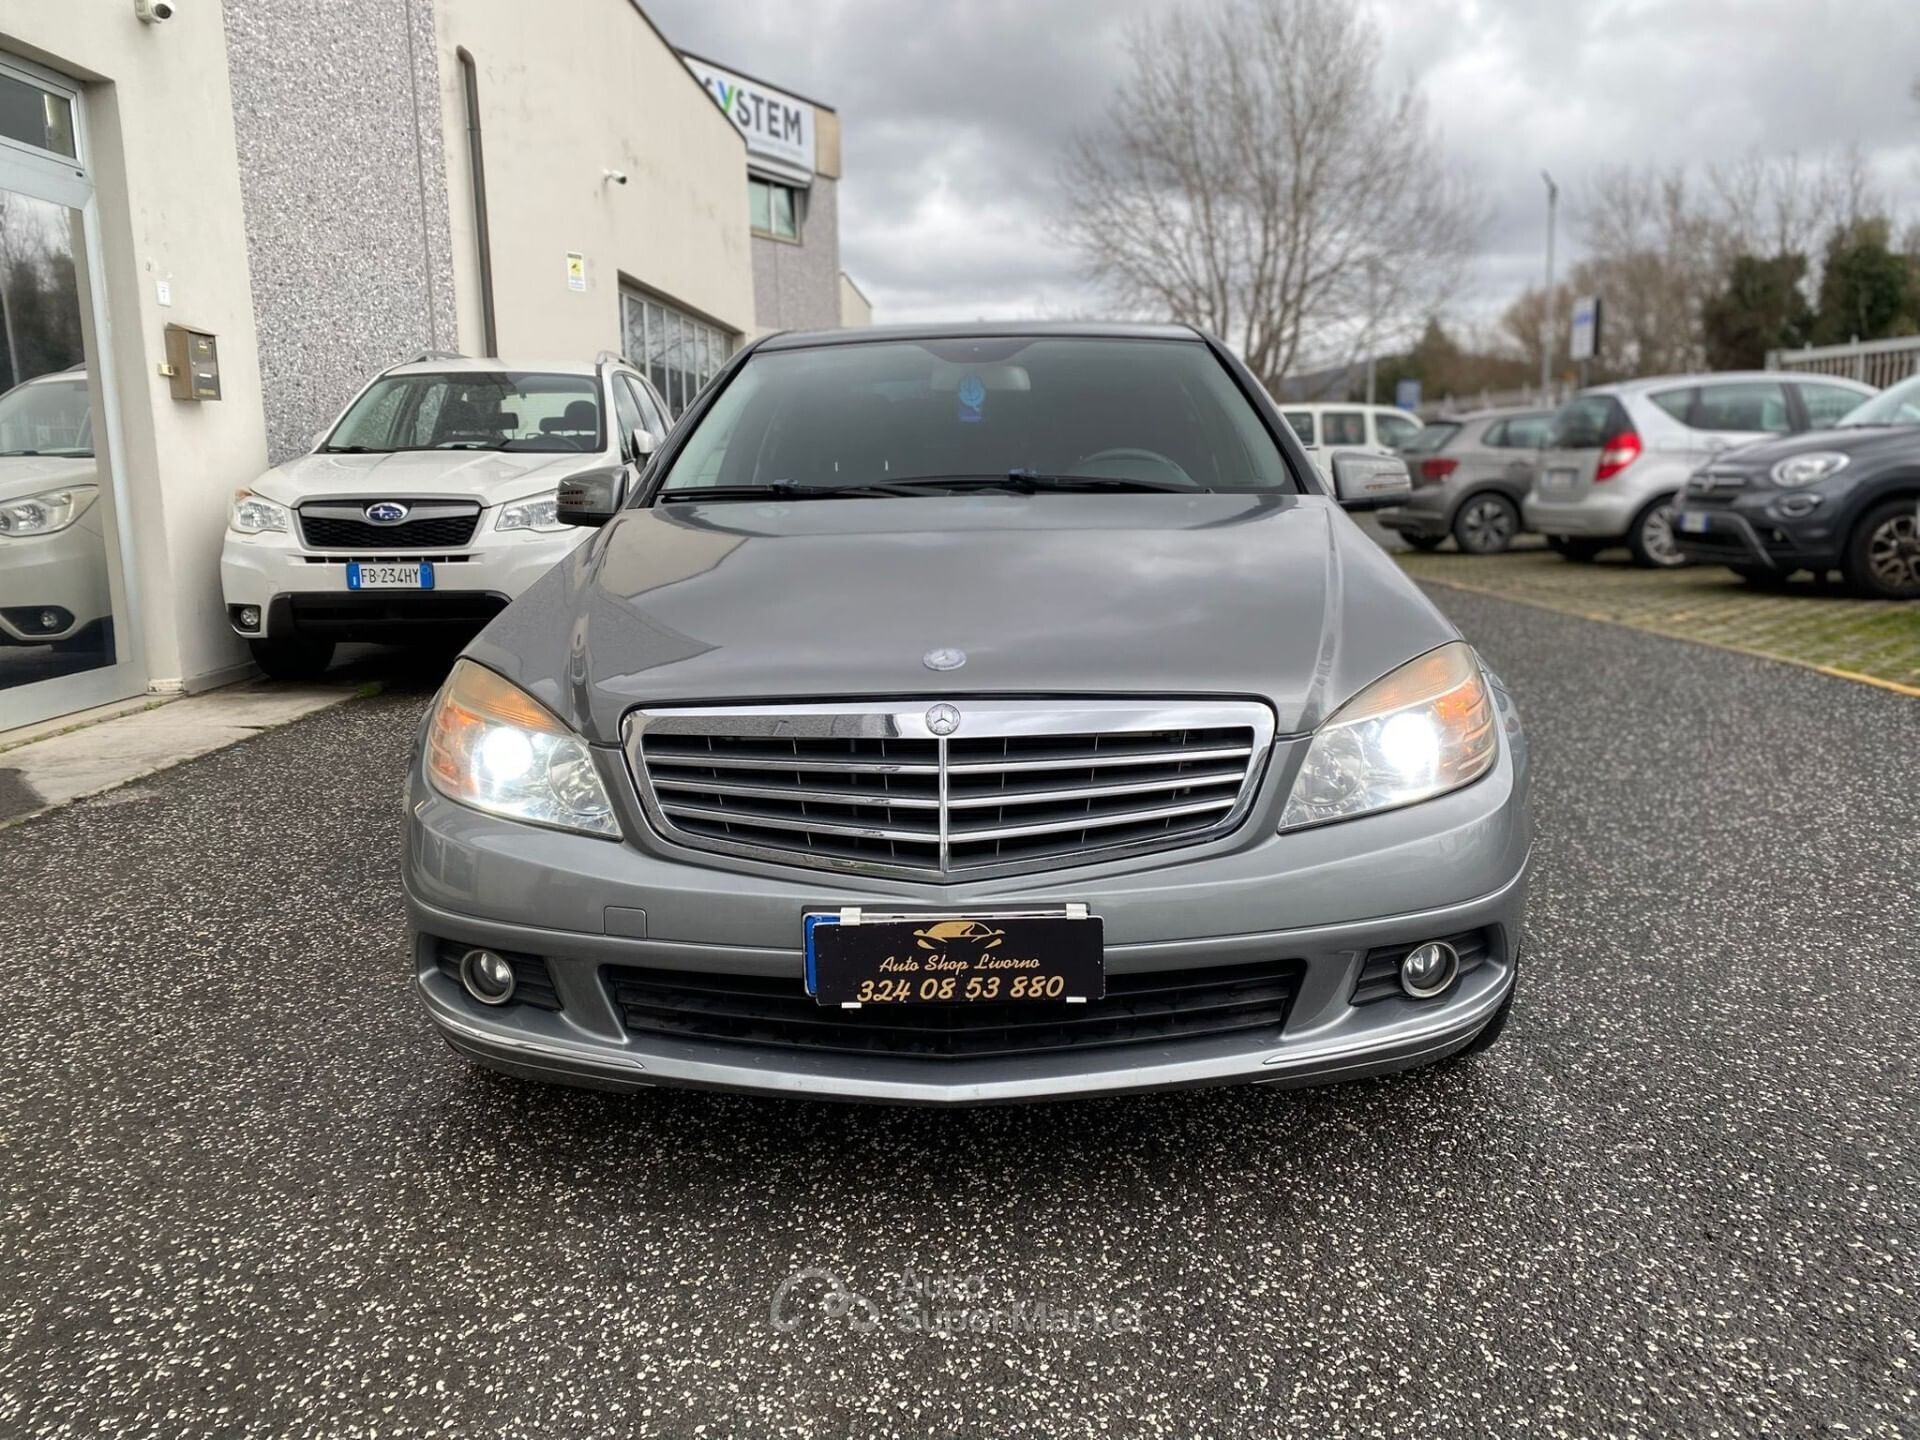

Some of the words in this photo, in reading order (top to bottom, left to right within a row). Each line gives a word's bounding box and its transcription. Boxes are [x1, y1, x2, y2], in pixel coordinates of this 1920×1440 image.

[879, 955, 920, 974] Auto
[924, 952, 969, 976] Shop
[974, 952, 1040, 971] Livorno
[856, 980, 911, 1002] 324
[919, 977, 957, 1000] 08
[965, 976, 1001, 1001] 53
[1009, 975, 1065, 999] 880
